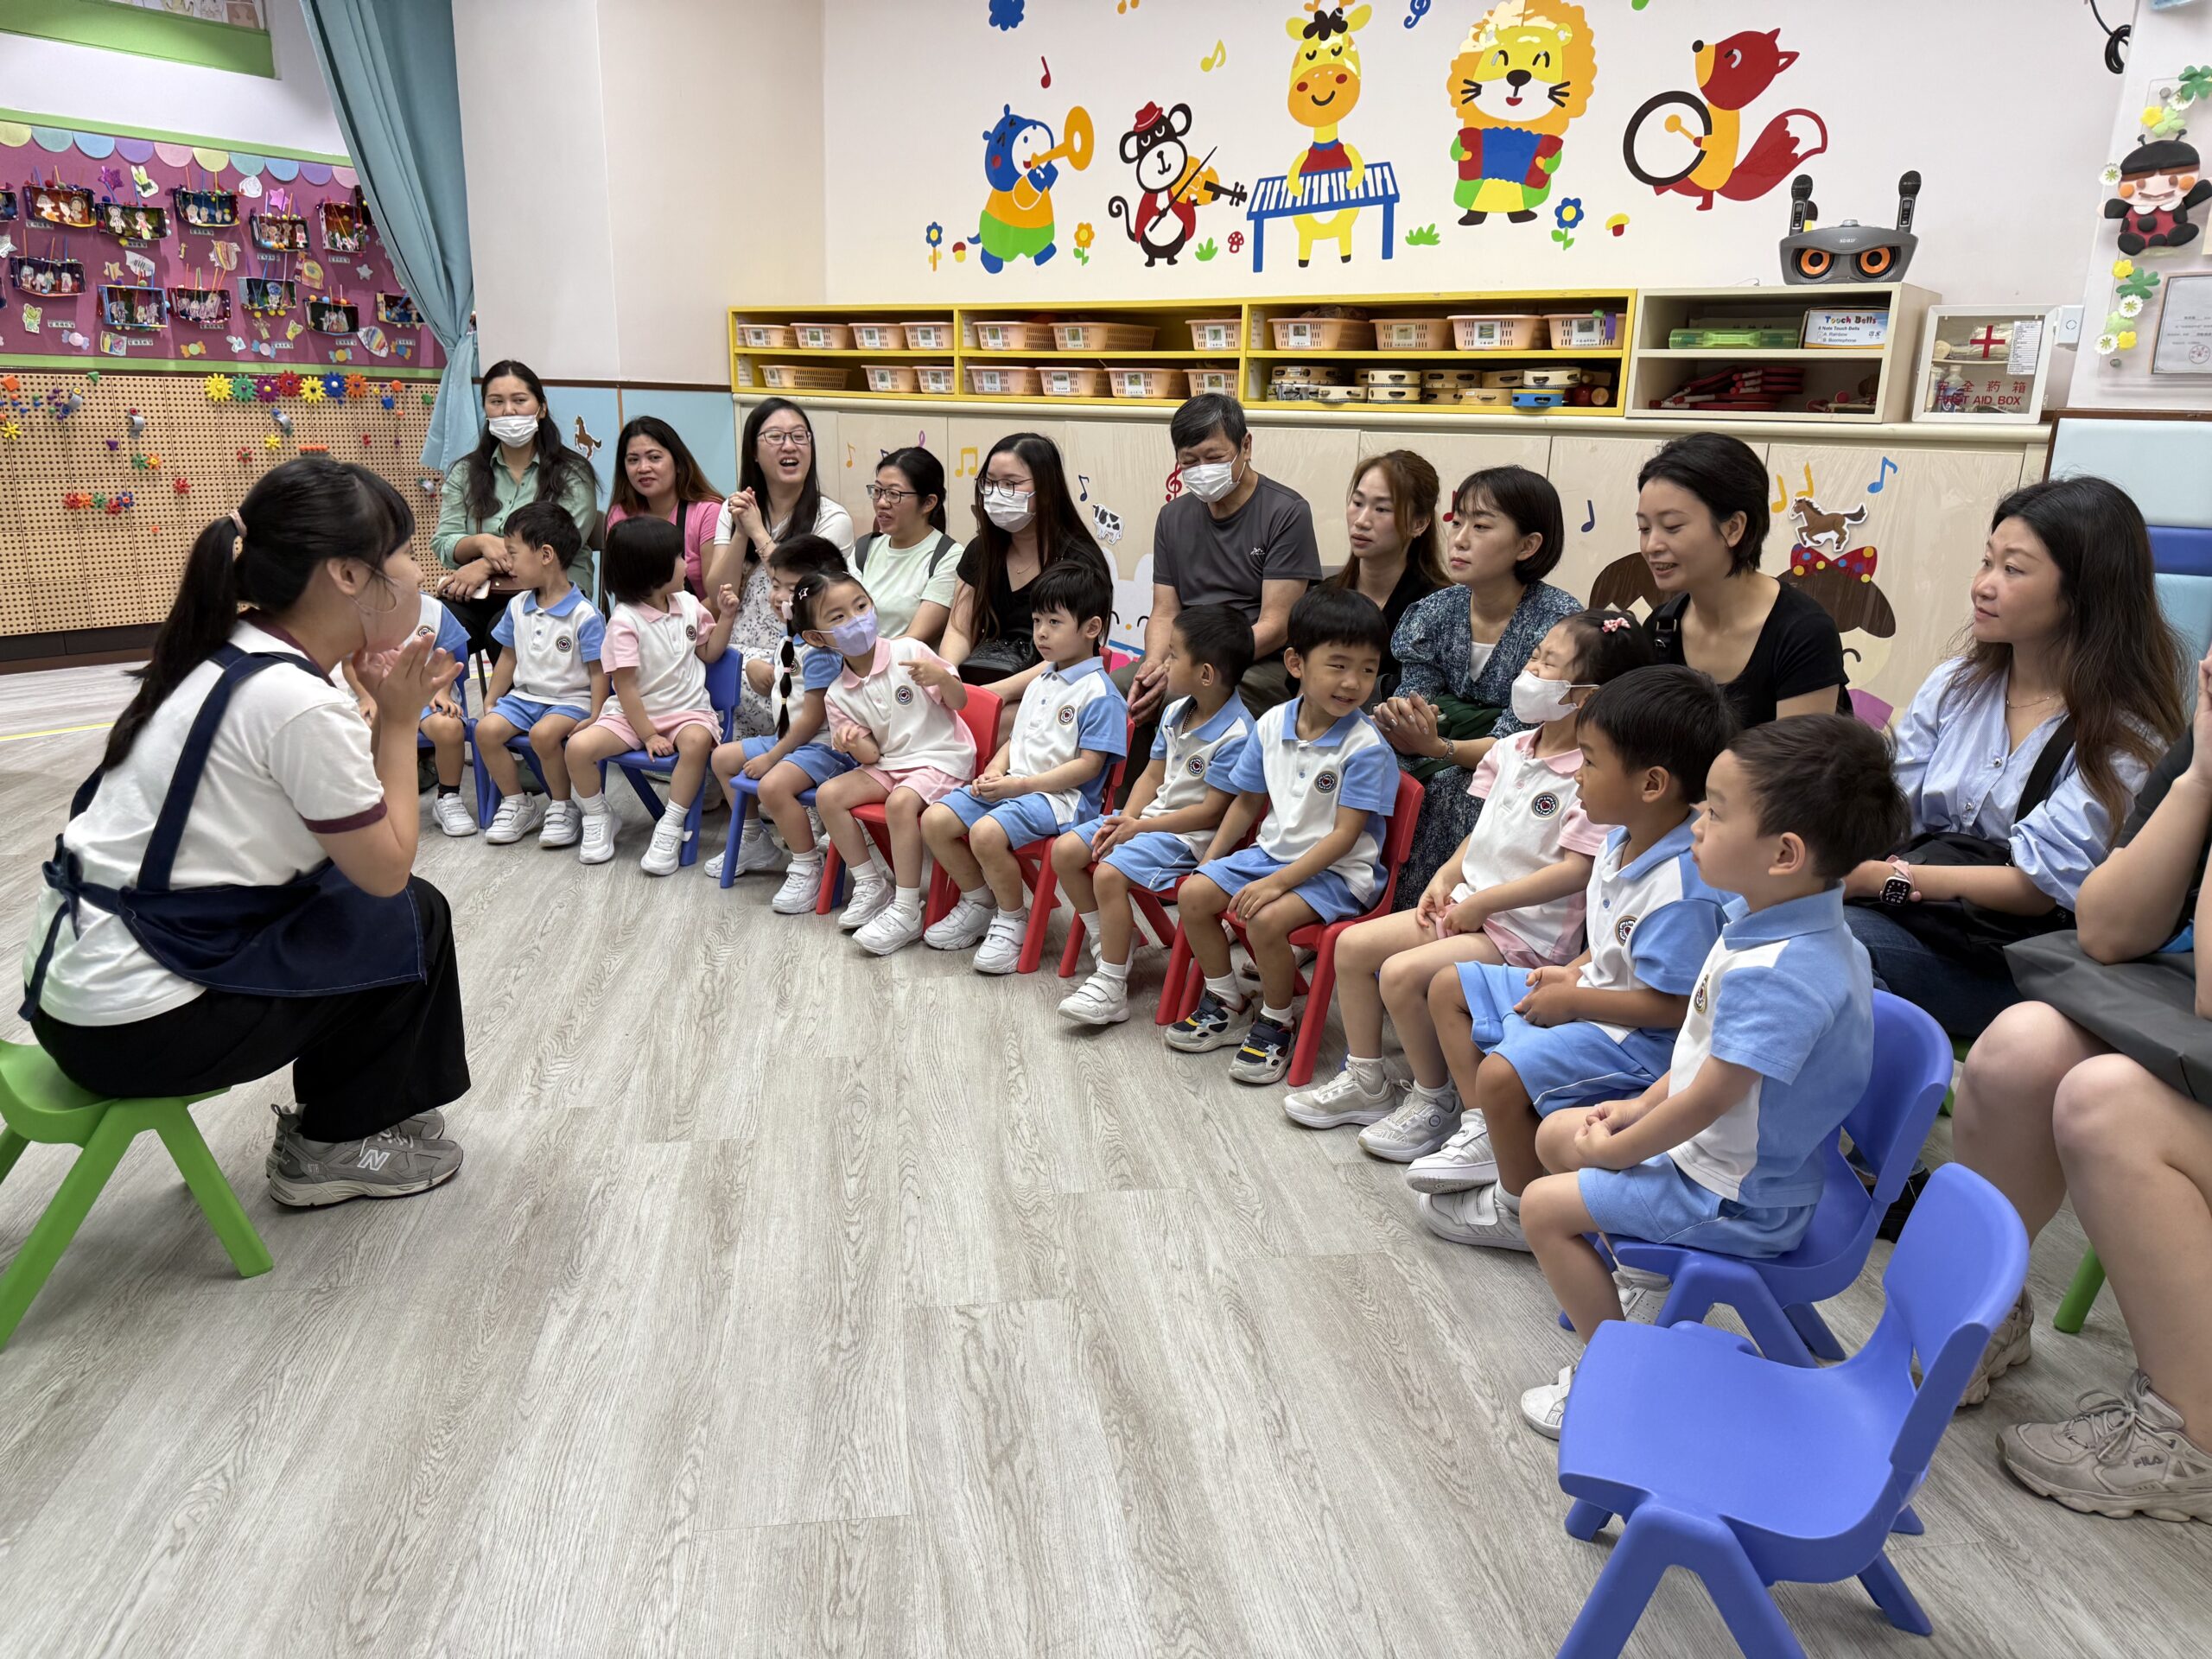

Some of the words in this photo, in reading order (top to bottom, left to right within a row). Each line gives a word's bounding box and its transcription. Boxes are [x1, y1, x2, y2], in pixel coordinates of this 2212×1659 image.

[1854, 315, 1877, 324] Bells
[1973, 396, 1993, 405] AID
[1998, 396, 2022, 405] BOX
[357, 1148, 391, 1171] N
[2133, 1455, 2164, 1468] FILA
